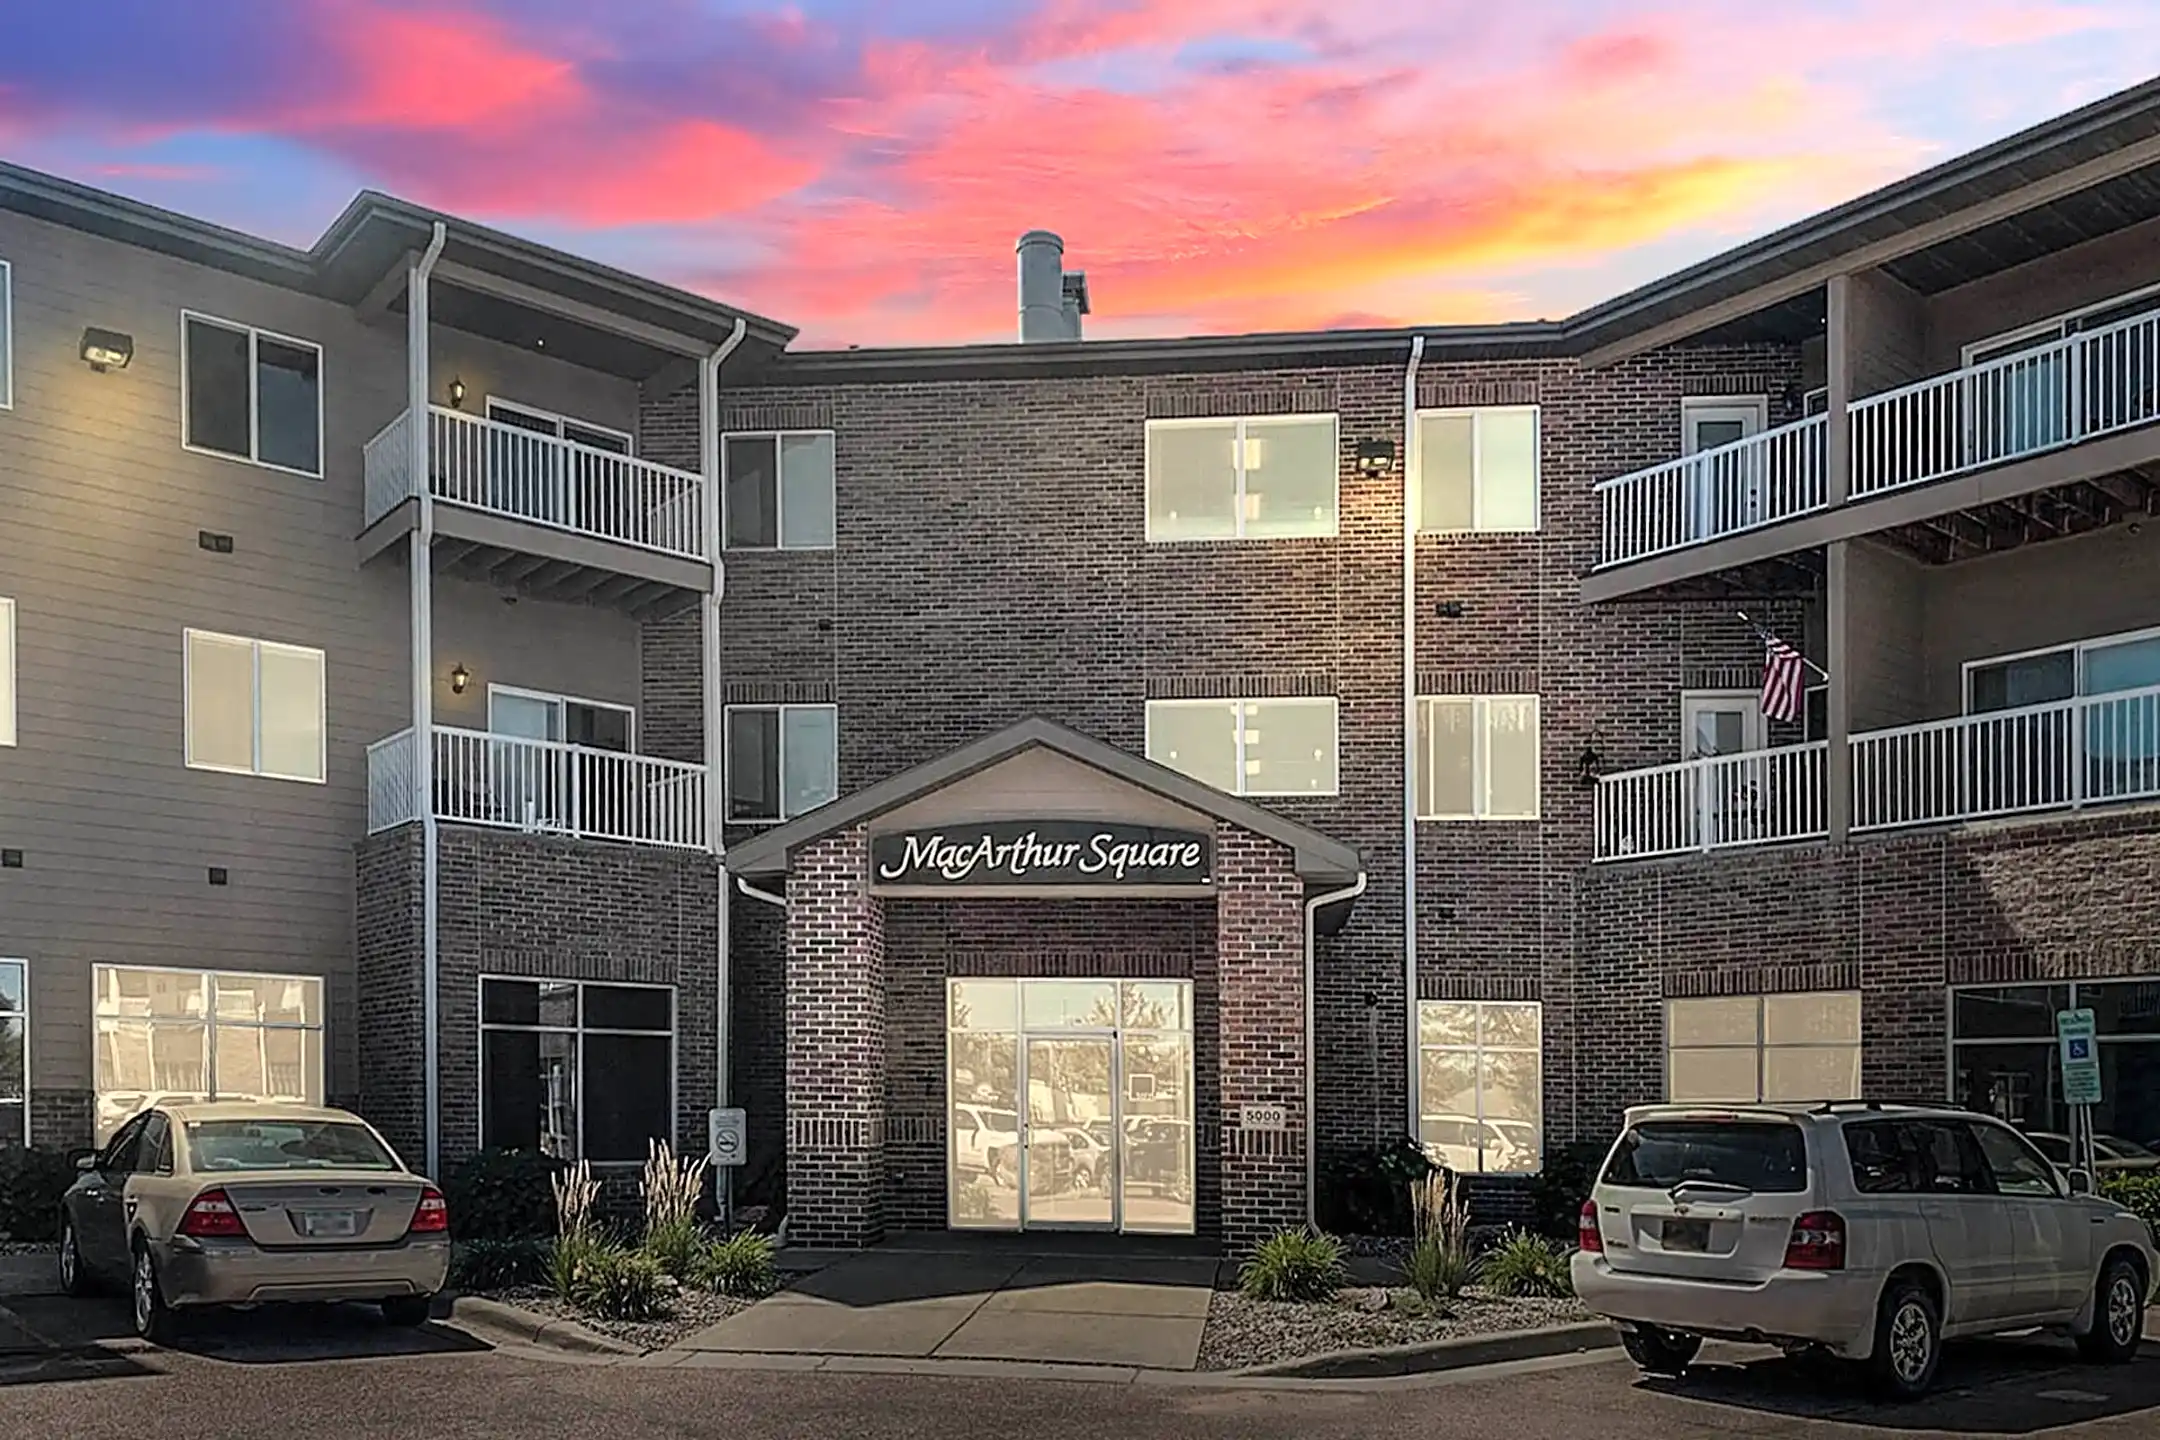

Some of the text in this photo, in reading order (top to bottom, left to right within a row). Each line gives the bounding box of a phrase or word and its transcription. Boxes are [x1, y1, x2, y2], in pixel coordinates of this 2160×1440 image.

[880, 831, 1200, 879] MacArthur Square
[1246, 1110, 1281, 1121] 5000
